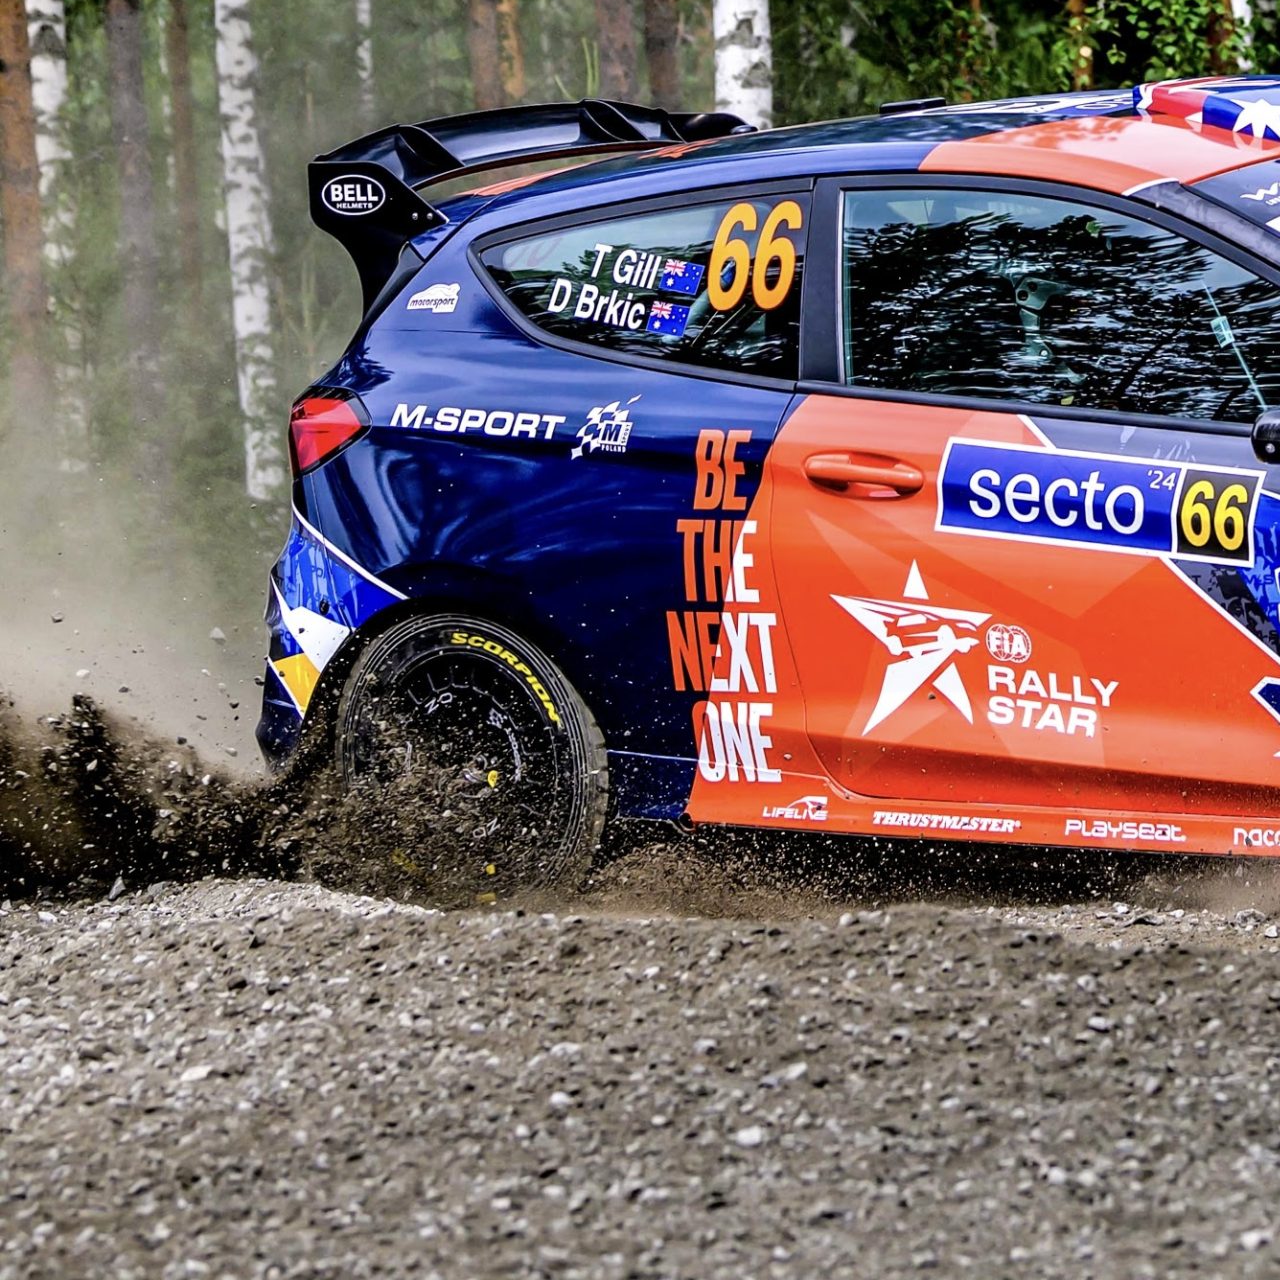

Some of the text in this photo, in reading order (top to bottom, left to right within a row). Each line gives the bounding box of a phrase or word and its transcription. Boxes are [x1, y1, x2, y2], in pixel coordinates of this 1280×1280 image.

[331, 184, 378, 202] BELL
[591, 243, 662, 290] T Gill
[707, 200, 802, 311] 66
[409, 296, 456, 309] motorsport
[548, 277, 646, 330] D Brkic
[389, 403, 567, 440] M-SPORT
[601, 443, 627, 453] POLAND
[693, 429, 753, 512] BE
[969, 468, 1144, 535] secto
[1181, 479, 1249, 551] 66
[676, 518, 760, 604] THE
[667, 611, 777, 694] NEXT
[451, 632, 564, 730] SCORPION
[987, 665, 1120, 707] RALLY
[691, 701, 782, 783] ONE
[987, 696, 1098, 738] STAR
